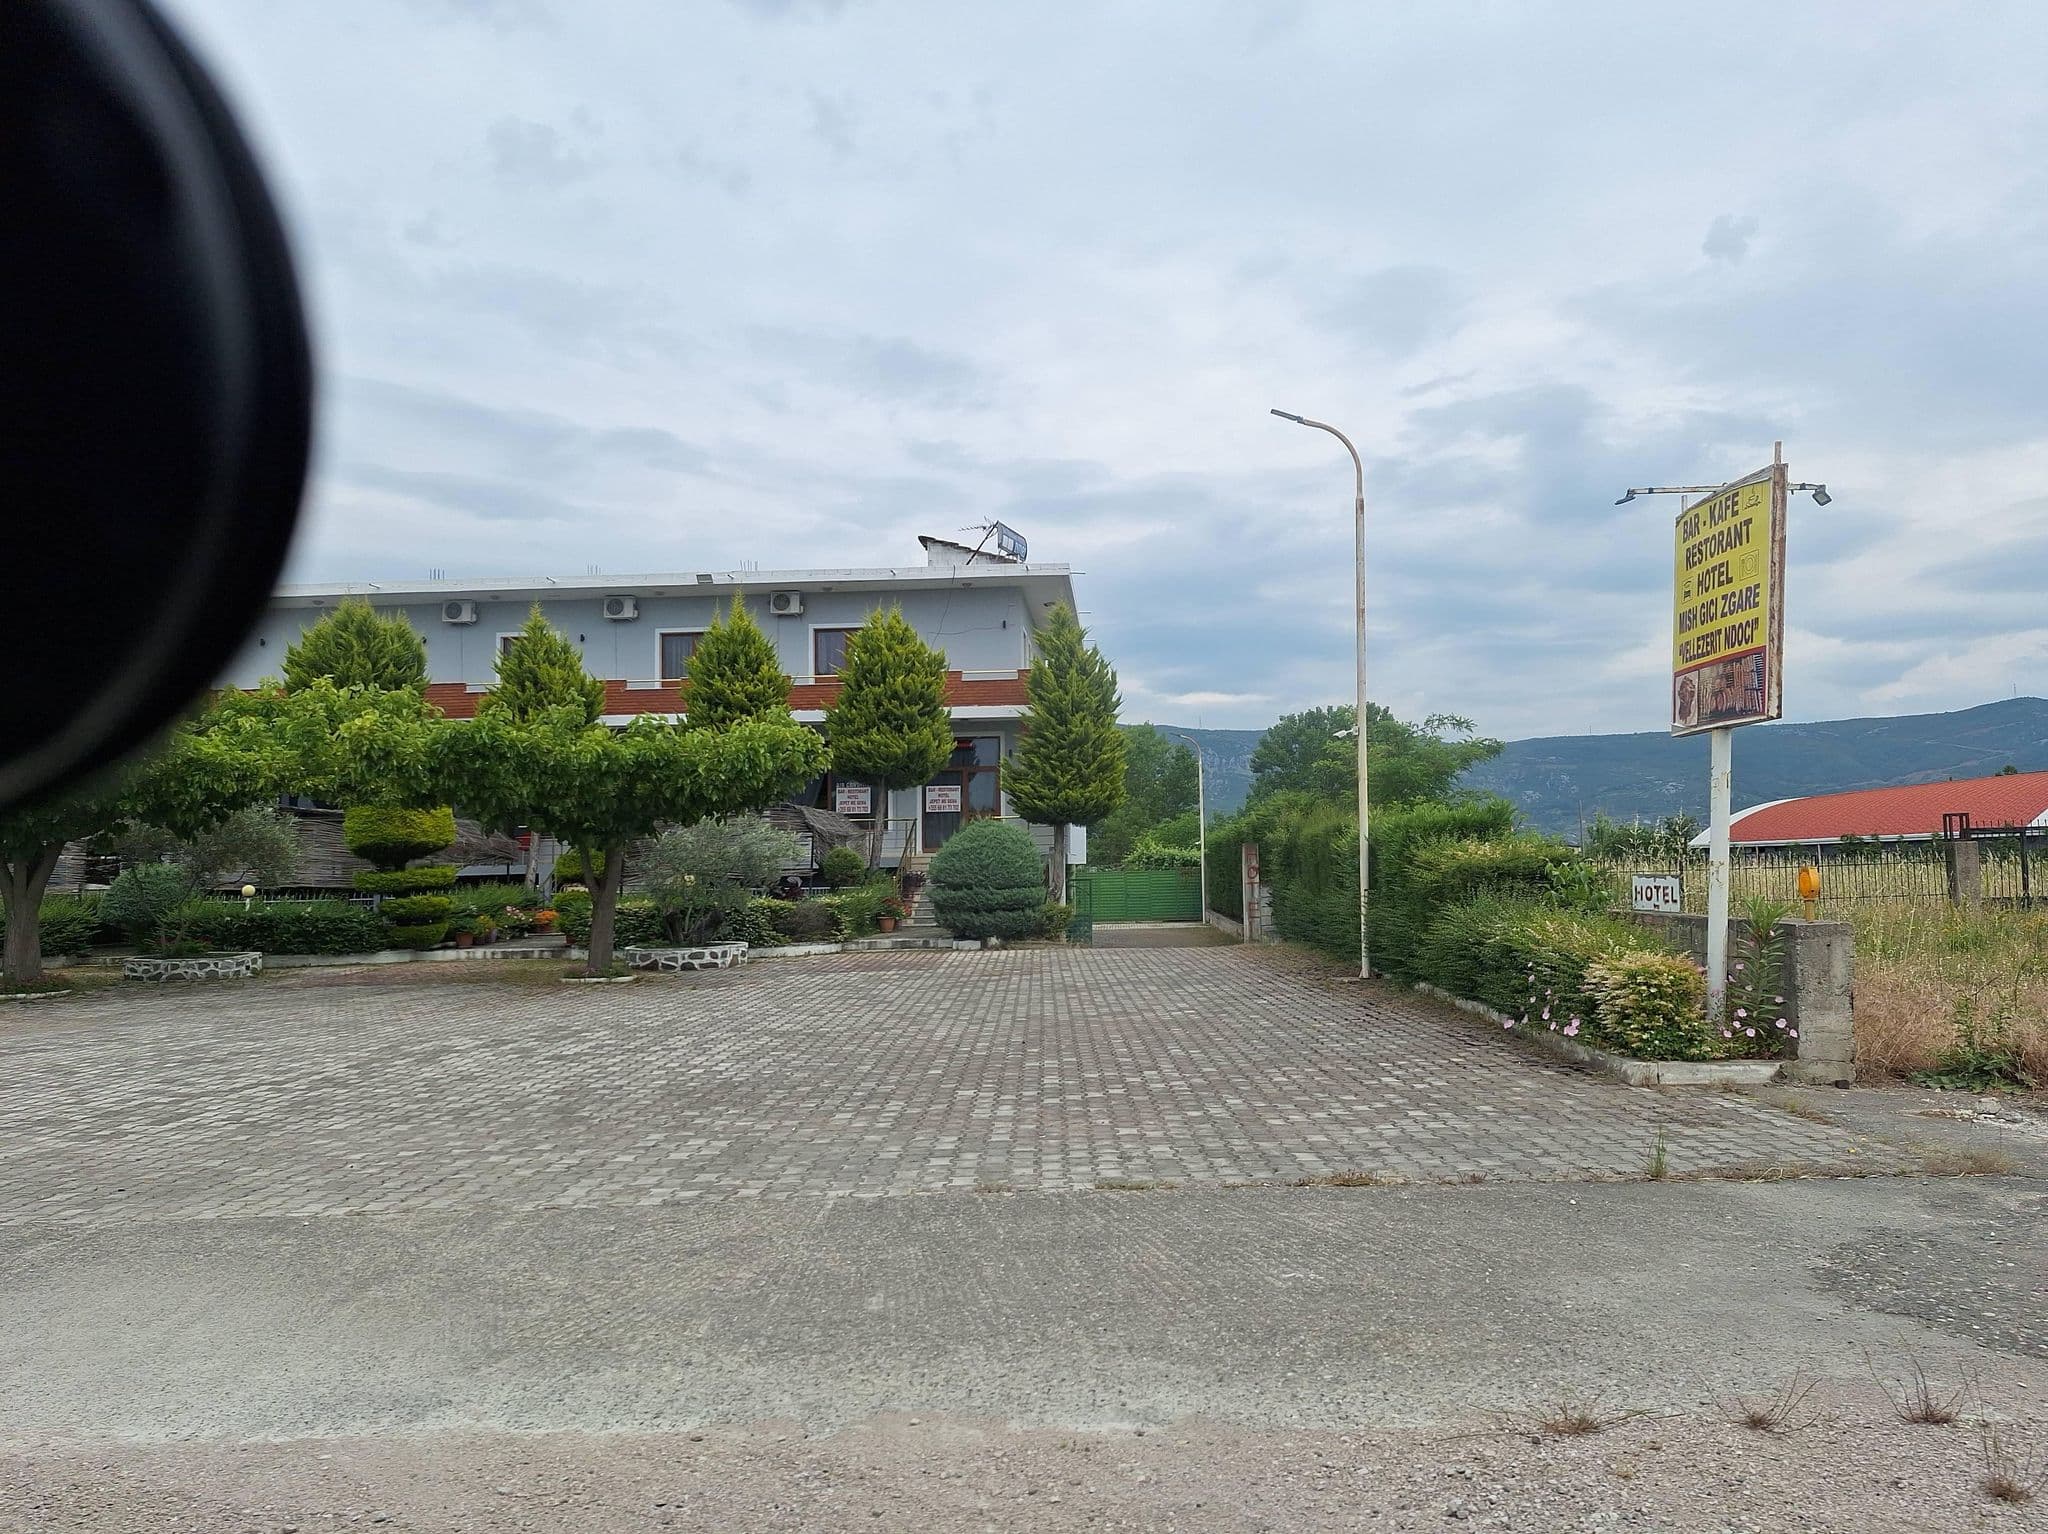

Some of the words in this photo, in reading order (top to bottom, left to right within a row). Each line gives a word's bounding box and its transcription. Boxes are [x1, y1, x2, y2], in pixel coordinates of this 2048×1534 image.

[1682, 513, 1700, 544] BAR
[1709, 491, 1740, 529] KAFE
[1685, 517, 1753, 571] RESTORANT
[1697, 560, 1733, 597] HOTEL
[1679, 605, 1698, 635] MISH
[1700, 597, 1718, 626] GICI
[1720, 583, 1761, 619] ZGARE
[1635, 885, 1678, 904] HOTEL
